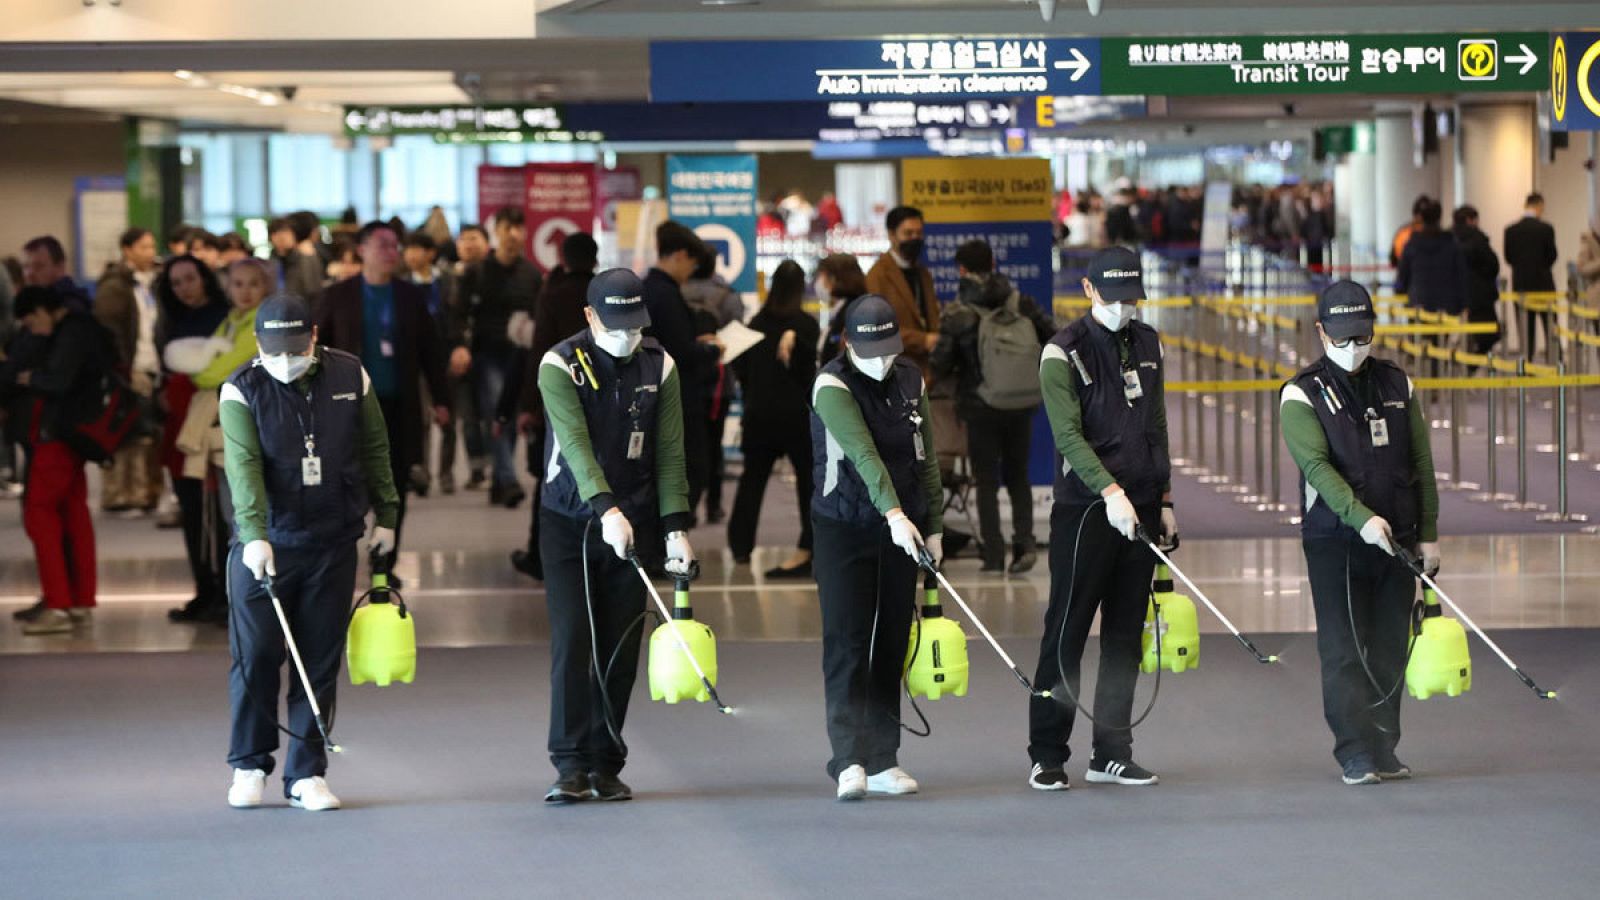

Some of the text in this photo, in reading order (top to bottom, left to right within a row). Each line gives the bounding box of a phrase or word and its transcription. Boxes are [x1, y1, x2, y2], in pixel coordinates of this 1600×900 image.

[881, 41, 1047, 69] 자동출입국심사
[1361, 47, 1446, 74] 환승투어
[818, 73, 1047, 94] Auto Immigration clearance
[1230, 63, 1350, 83] Transit Tour
[1036, 96, 1055, 127] E
